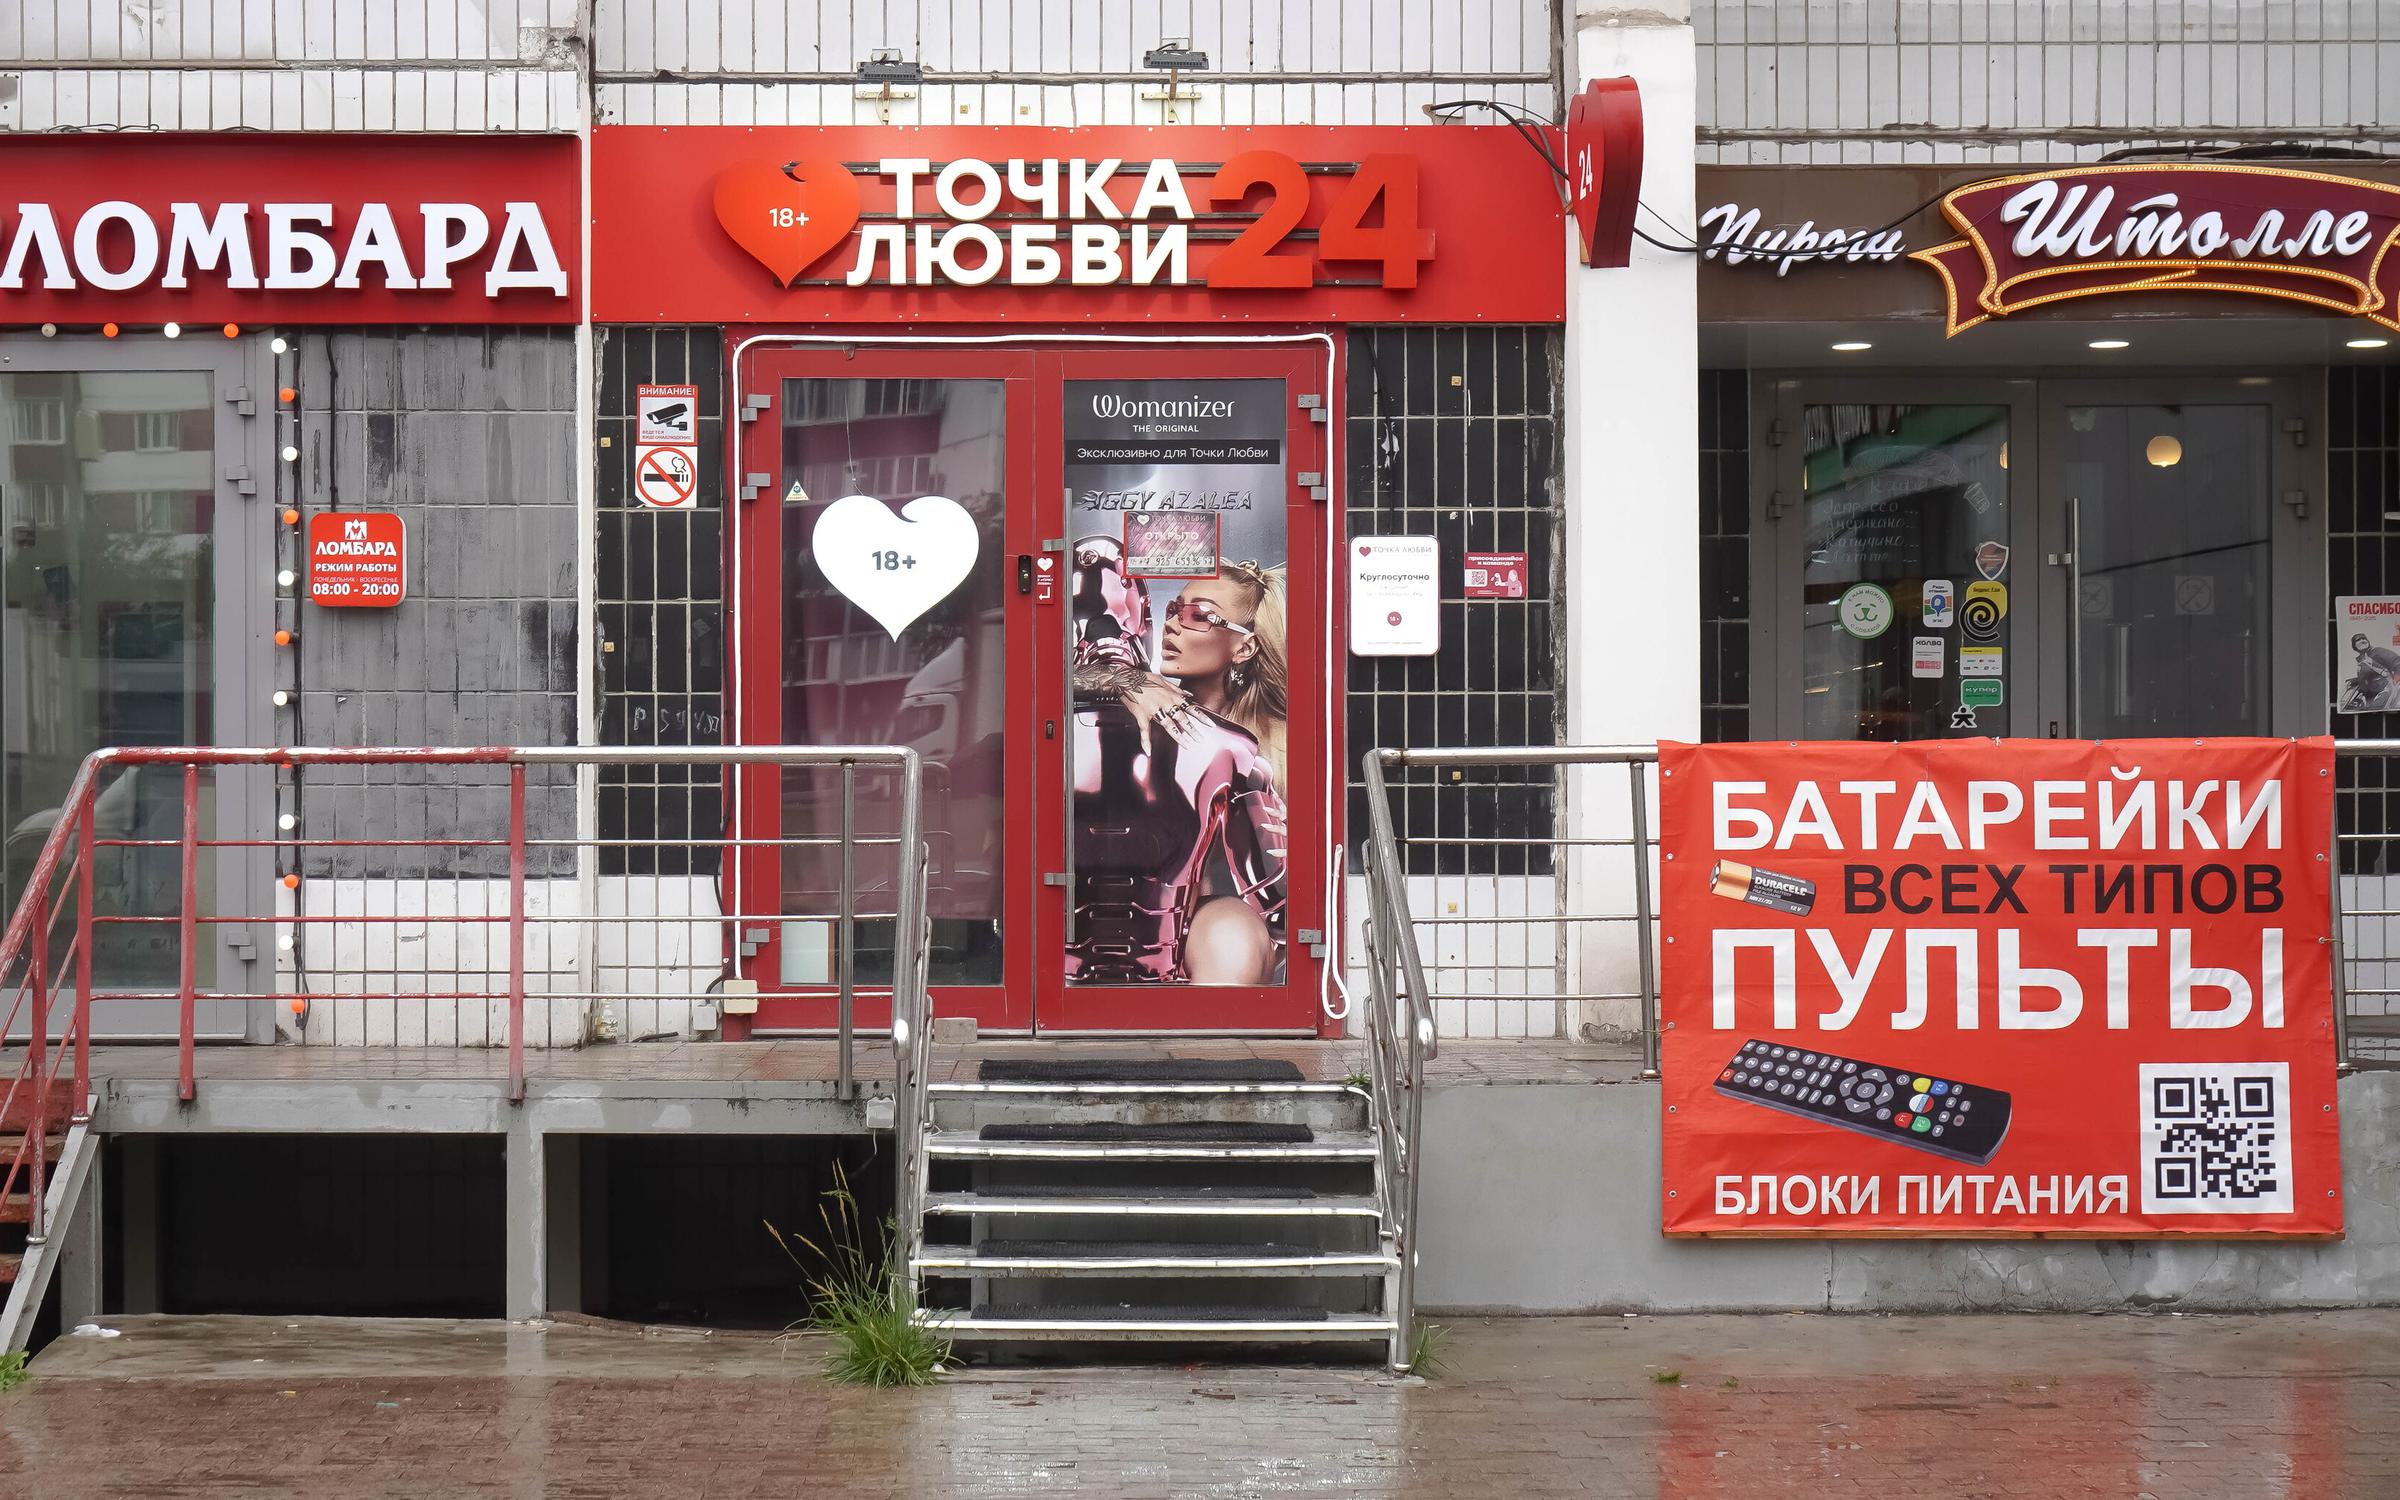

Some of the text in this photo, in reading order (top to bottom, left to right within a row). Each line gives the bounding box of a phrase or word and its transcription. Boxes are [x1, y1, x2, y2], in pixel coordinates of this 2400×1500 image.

[1579, 143, 1593, 200] 24
[879, 158, 1195, 222] ТОЧКА
[769, 207, 810, 228] 18+
[1206, 150, 1436, 288] 24
[2000, 179, 2373, 260] Штолле
[0, 200, 568, 297] ЛОМБАРД
[1697, 203, 1908, 278] Пироги
[846, 223, 1189, 287] ЛЮБВИ
[640, 387, 695, 396] ВНИМАНИЕ!
[1092, 394, 1236, 419] Womanizer
[1132, 424, 1200, 433] THE ORIGINAL
[1077, 447, 1269, 460] Эксклюзивно для Точки Любви
[1158, 490, 1252, 511] AZALEA
[315, 541, 397, 557] ЛОМБАРД
[871, 550, 917, 571] 18+
[1373, 546, 1432, 554] ТОЧКА ЛЮБВИ
[315, 563, 397, 572] РЕЖИМ РАБОТЫ
[1359, 573, 1430, 582] Круглосуточно
[312, 583, 350, 595] 08:00
[361, 583, 400, 595] 20:00
[2349, 602, 2400, 615] СПАСИБО
[1713, 766, 2283, 851] БАТАРЕЙКИ
[1843, 863, 2283, 914] ВСЕХ ТИПОВ
[1712, 928, 2285, 1031] ПУЛЬТЫ
[1714, 1174, 2129, 1215] БЛОКИ ПИТАНИЯ
